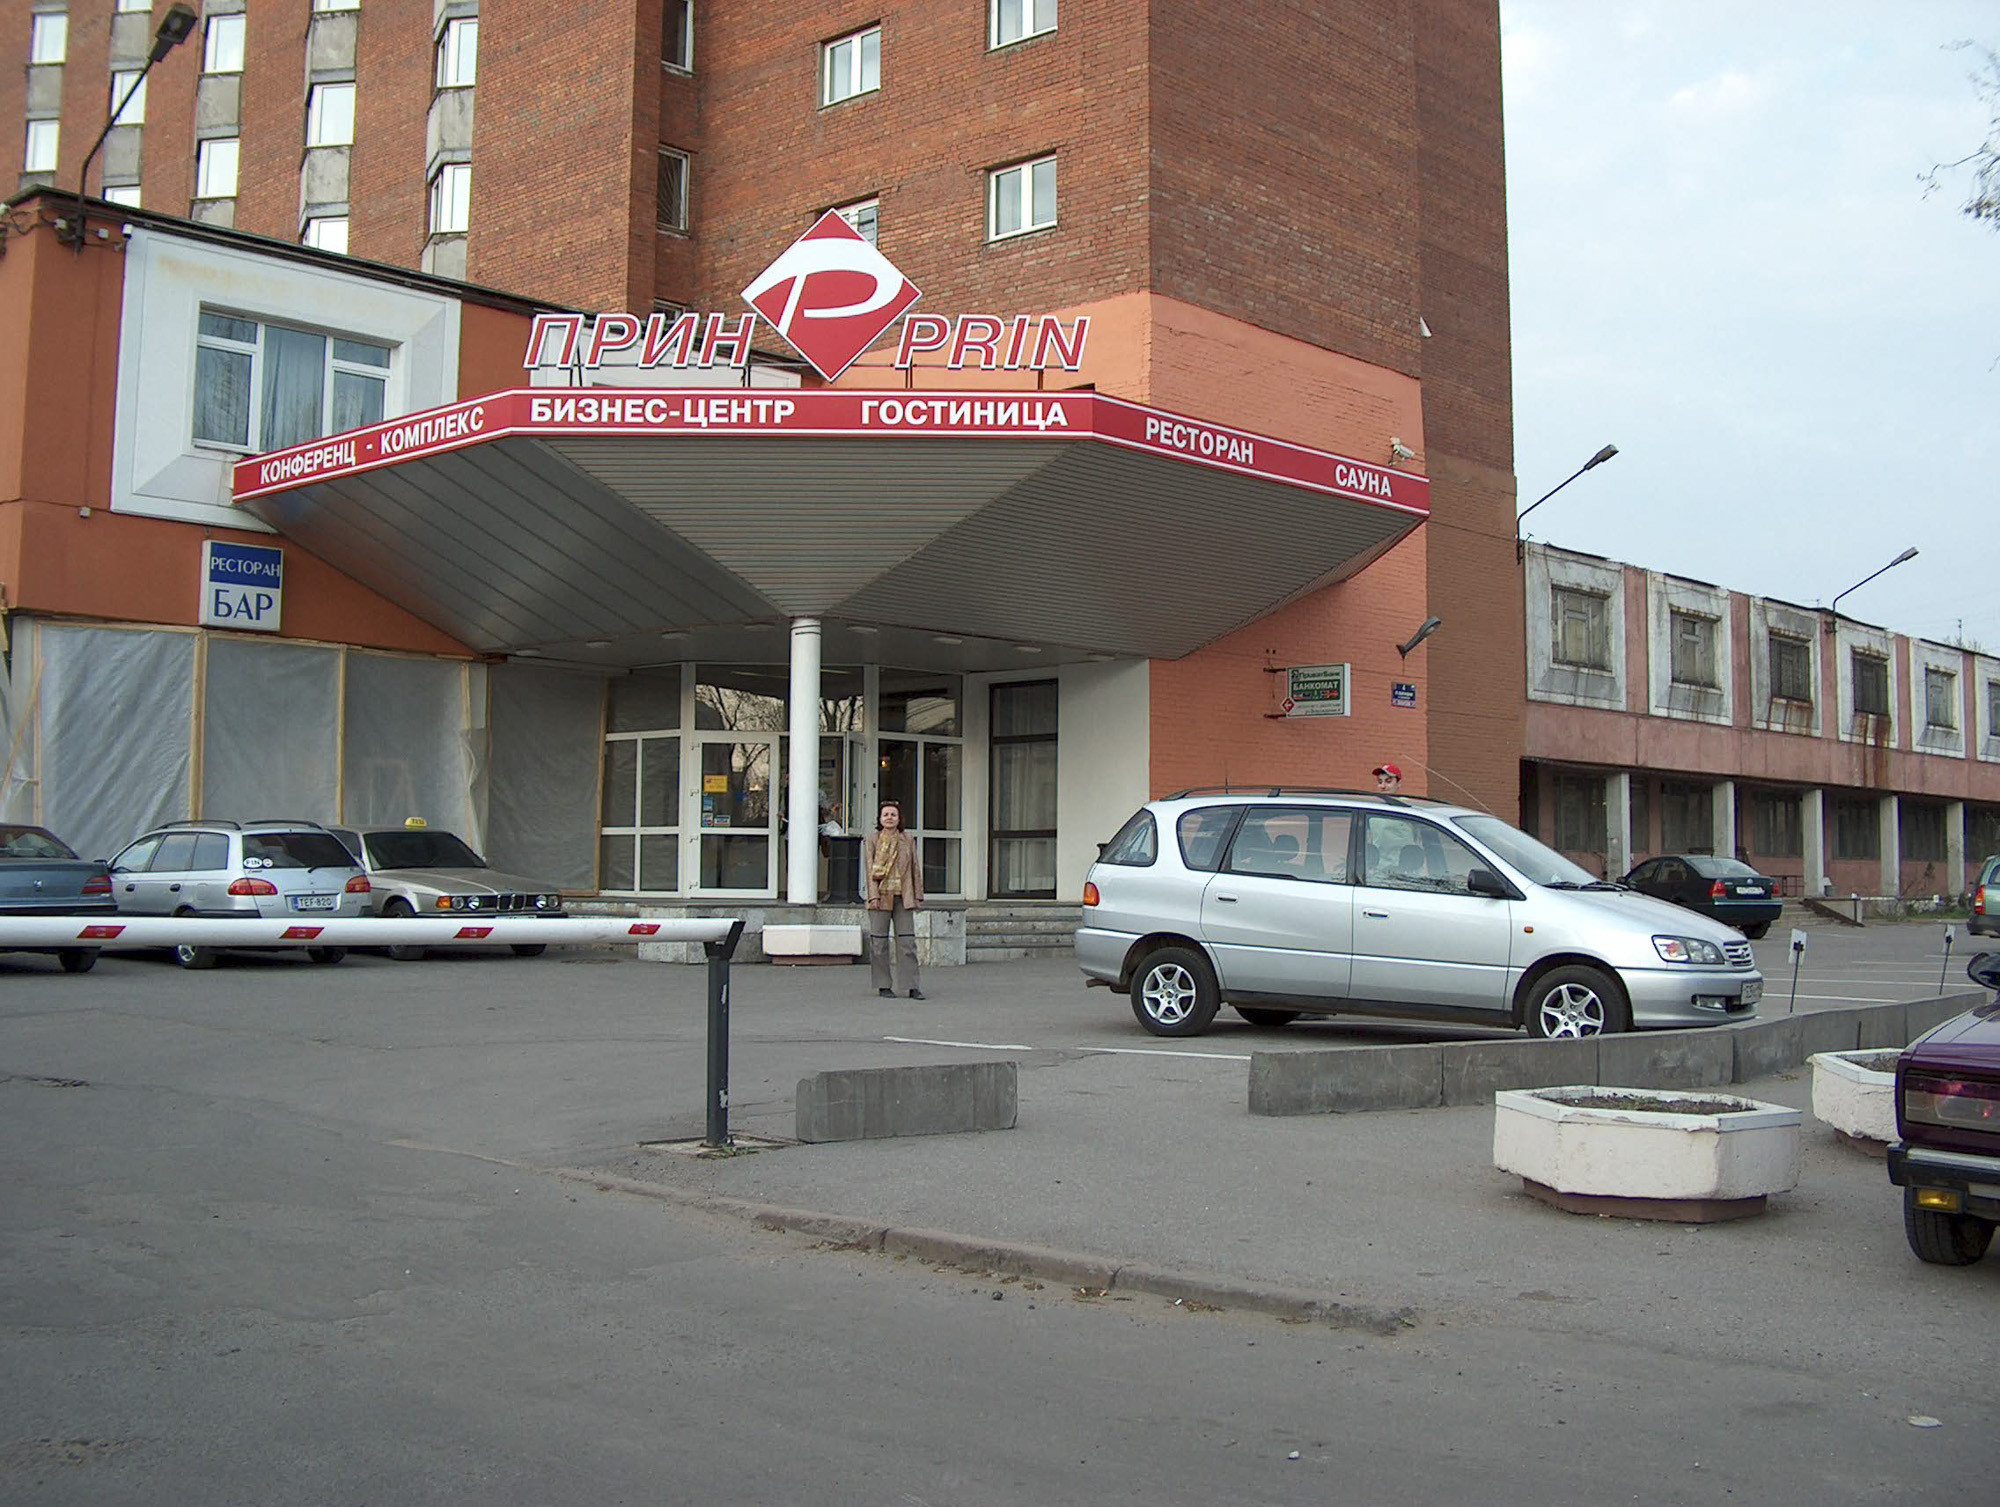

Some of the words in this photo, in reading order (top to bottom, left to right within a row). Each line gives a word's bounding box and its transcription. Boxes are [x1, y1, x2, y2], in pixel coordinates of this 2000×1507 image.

[523, 313, 757, 369] ПРИН
[895, 314, 1090, 370] PRIN
[530, 398, 795, 427] БИЗНЕС-ЦЕНТР
[861, 400, 1068, 430] ГОСТИНИЦА
[260, 440, 356, 484] КОНФЕРЕНЦ
[380, 406, 484, 454] КОМПЛЕКС
[1146, 417, 1254, 465] РЕСТОРАН
[1334, 464, 1392, 497] САУНА
[210, 556, 280, 577] РЕСТОРАН
[214, 589, 273, 620] БАР
